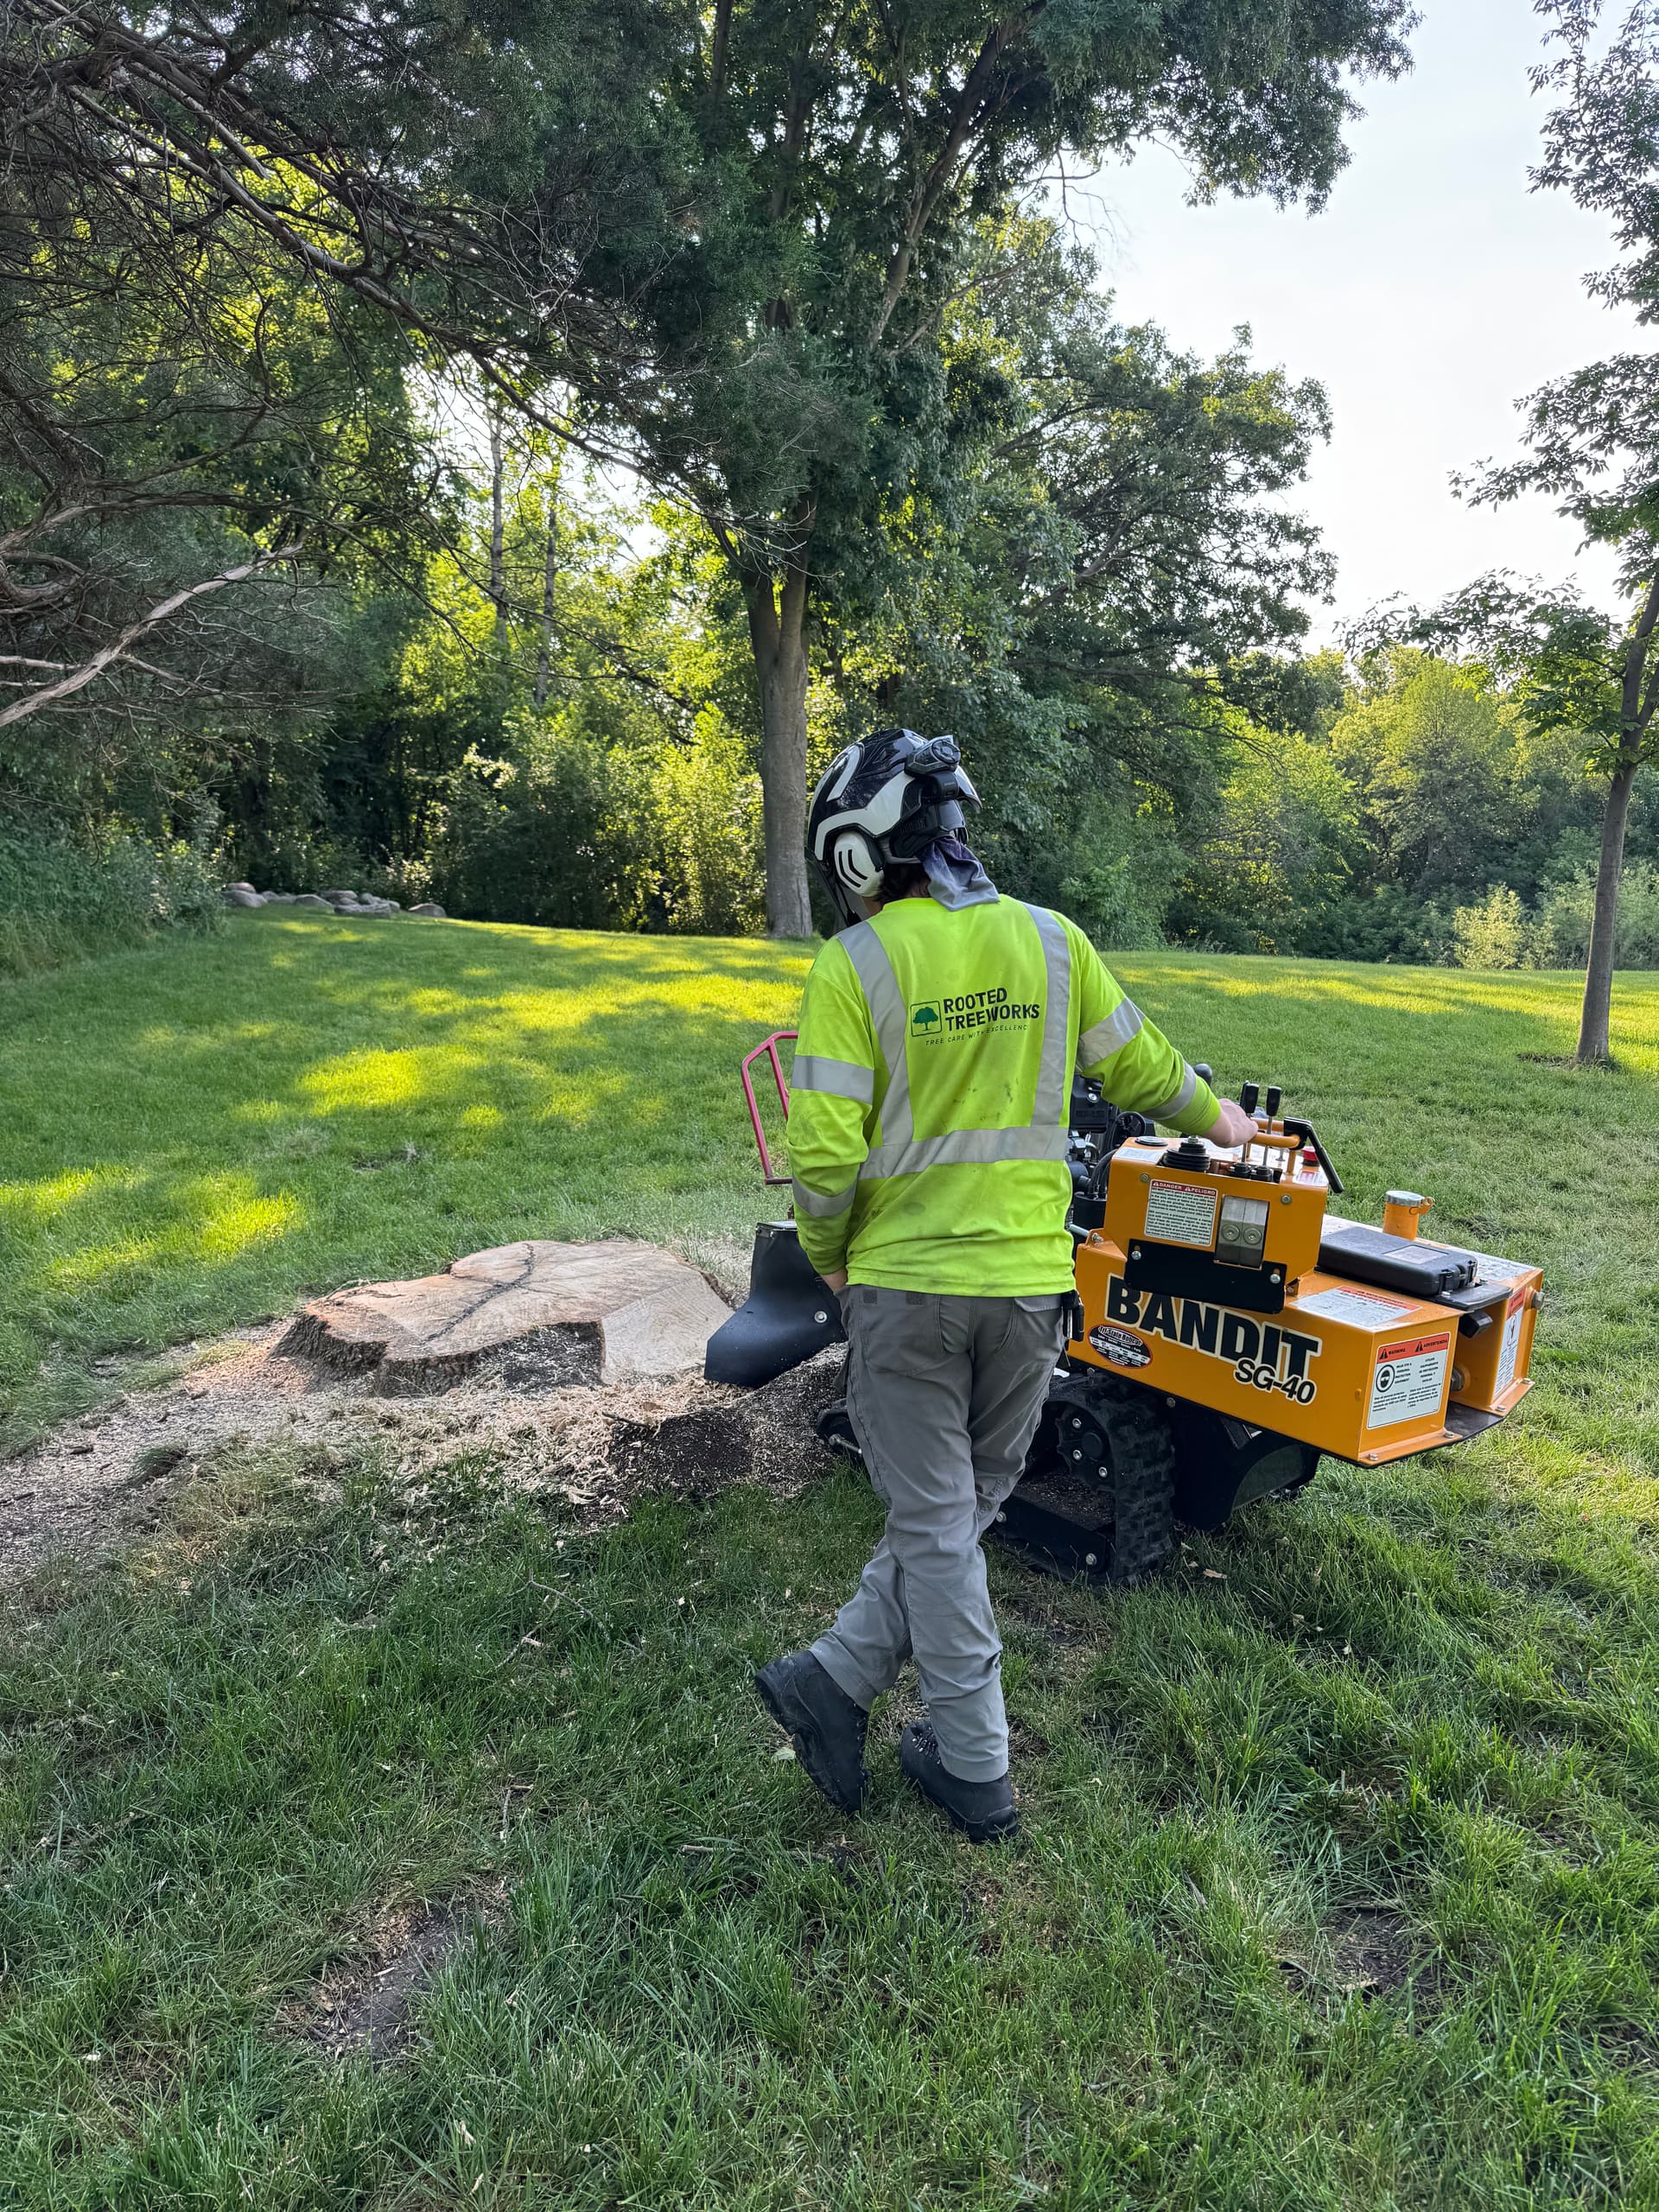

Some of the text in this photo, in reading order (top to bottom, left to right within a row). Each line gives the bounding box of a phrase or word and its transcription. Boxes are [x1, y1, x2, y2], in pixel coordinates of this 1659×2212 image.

[943, 988, 1007, 1014] ROOTED
[945, 1004, 1039, 1031] TREEWORKS
[948, 1034, 964, 1043] CARE
[968, 1029, 984, 1039] WITH
[986, 1025, 1027, 1033] EXCELLENC
[1106, 1274, 1320, 1381] BANDIT
[1234, 1359, 1316, 1405] SG-40
